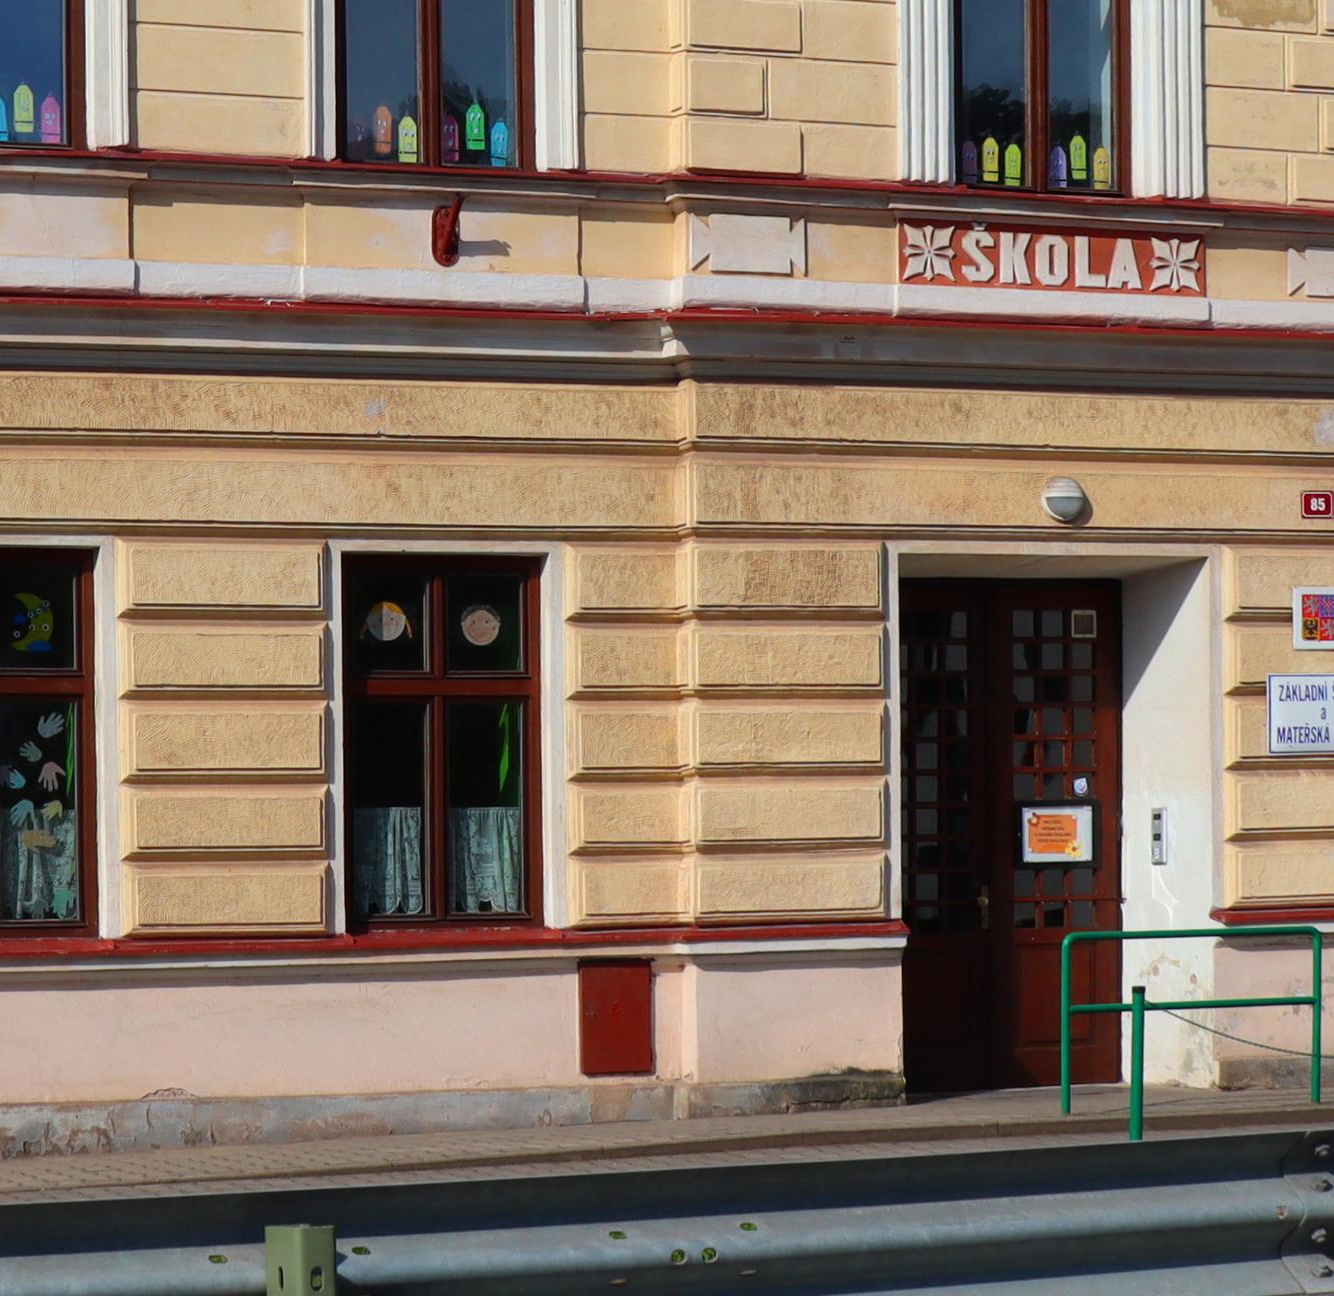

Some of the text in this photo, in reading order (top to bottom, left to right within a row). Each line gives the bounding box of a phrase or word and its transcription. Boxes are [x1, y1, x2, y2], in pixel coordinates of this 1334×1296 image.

[961, 222, 1143, 289] ŠKOLA
[1310, 497, 1326, 511] 85
[1278, 681, 1328, 702] ZÁKLADNÍ
[1320, 707, 1327, 720] a
[1277, 723, 1329, 744] MATEŘSKÁ
